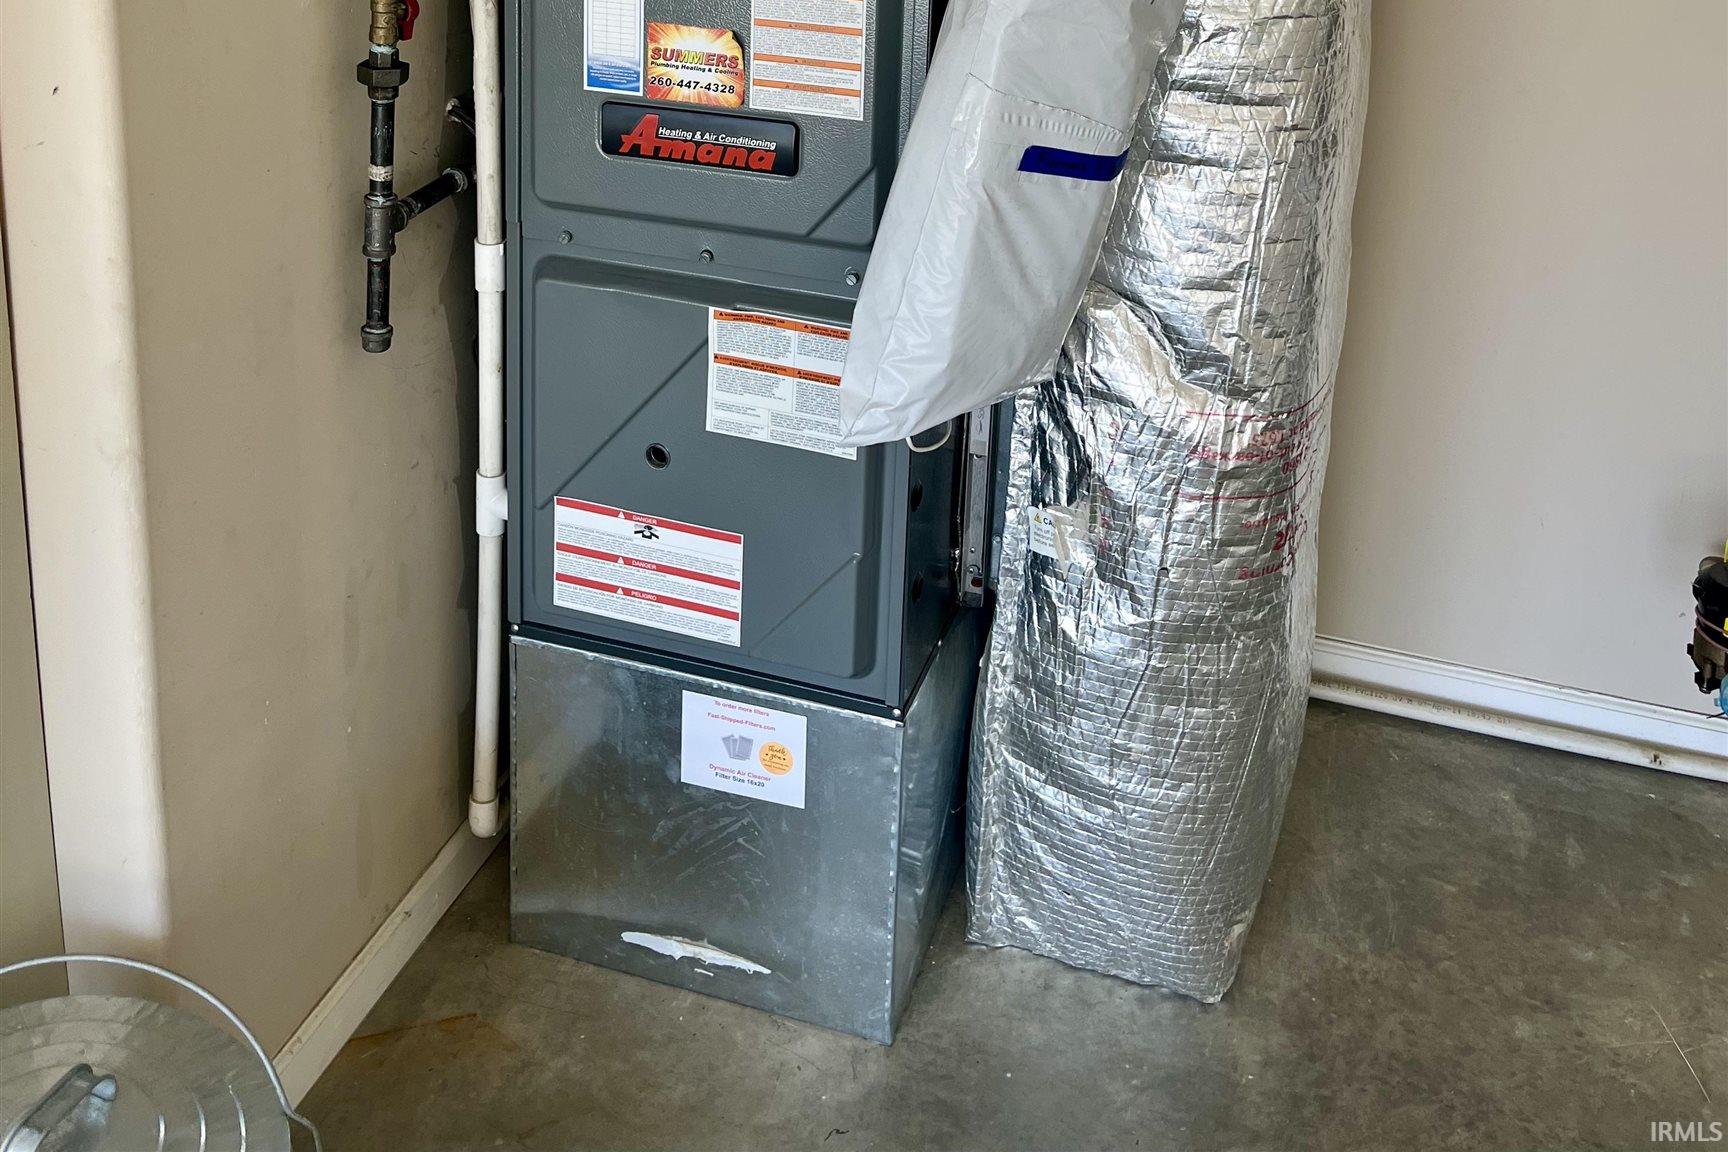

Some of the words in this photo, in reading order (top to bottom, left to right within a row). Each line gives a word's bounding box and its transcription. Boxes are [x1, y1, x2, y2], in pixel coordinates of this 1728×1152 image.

[650, 47, 740, 68] SUMMERS
[651, 61, 680, 69] Plumbing
[681, 64, 706, 73] Heating
[715, 68, 739, 76] Cooling
[650, 76, 735, 94] 260-447-4328
[619, 113, 777, 171] Amana
[658, 126, 692, 140] Heating
[695, 131, 701, 139] &
[704, 132, 717, 141] Air
[719, 134, 777, 150] Conditioning
[632, 515, 658, 525] DANGER
[632, 560, 657, 570] DANGER
[631, 591, 657, 601] PELIGRO
[722, 702, 737, 710] order
[754, 709, 770, 717] filters
[709, 763, 735, 775] Dynamic
[748, 772, 771, 782] Cleaner
[715, 771, 731, 780] Filter
[733, 774, 745, 784] Size
